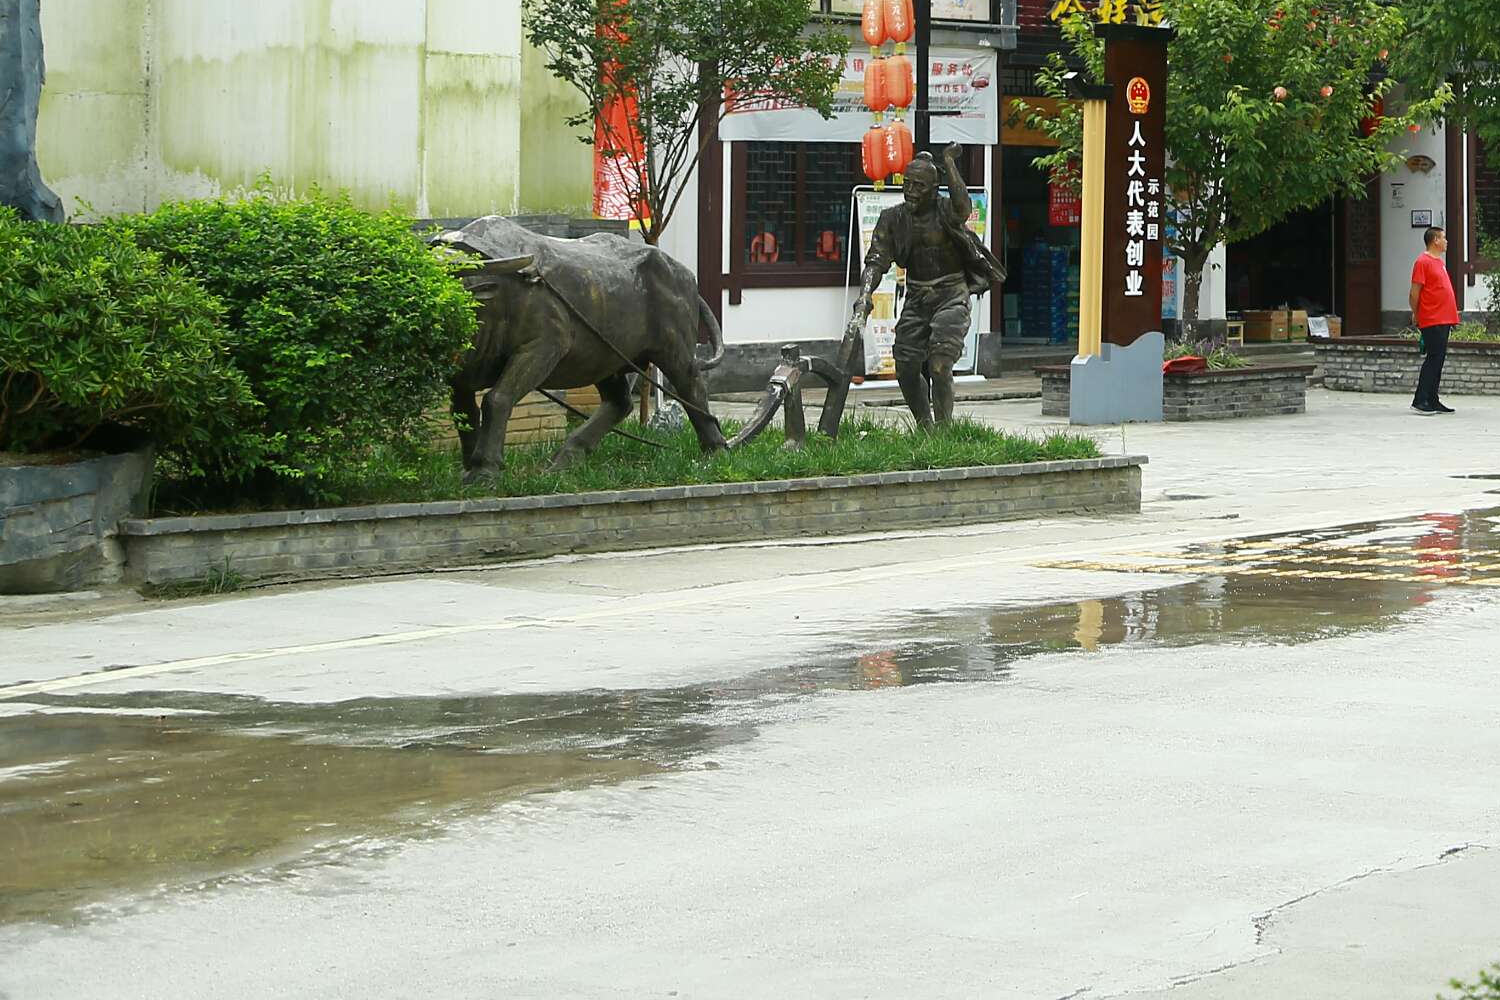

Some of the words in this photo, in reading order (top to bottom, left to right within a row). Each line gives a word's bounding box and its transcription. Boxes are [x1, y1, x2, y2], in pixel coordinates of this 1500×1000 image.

[1124, 120, 1147, 297] 人大代表创业
[1146, 178, 1160, 241] 示范园
